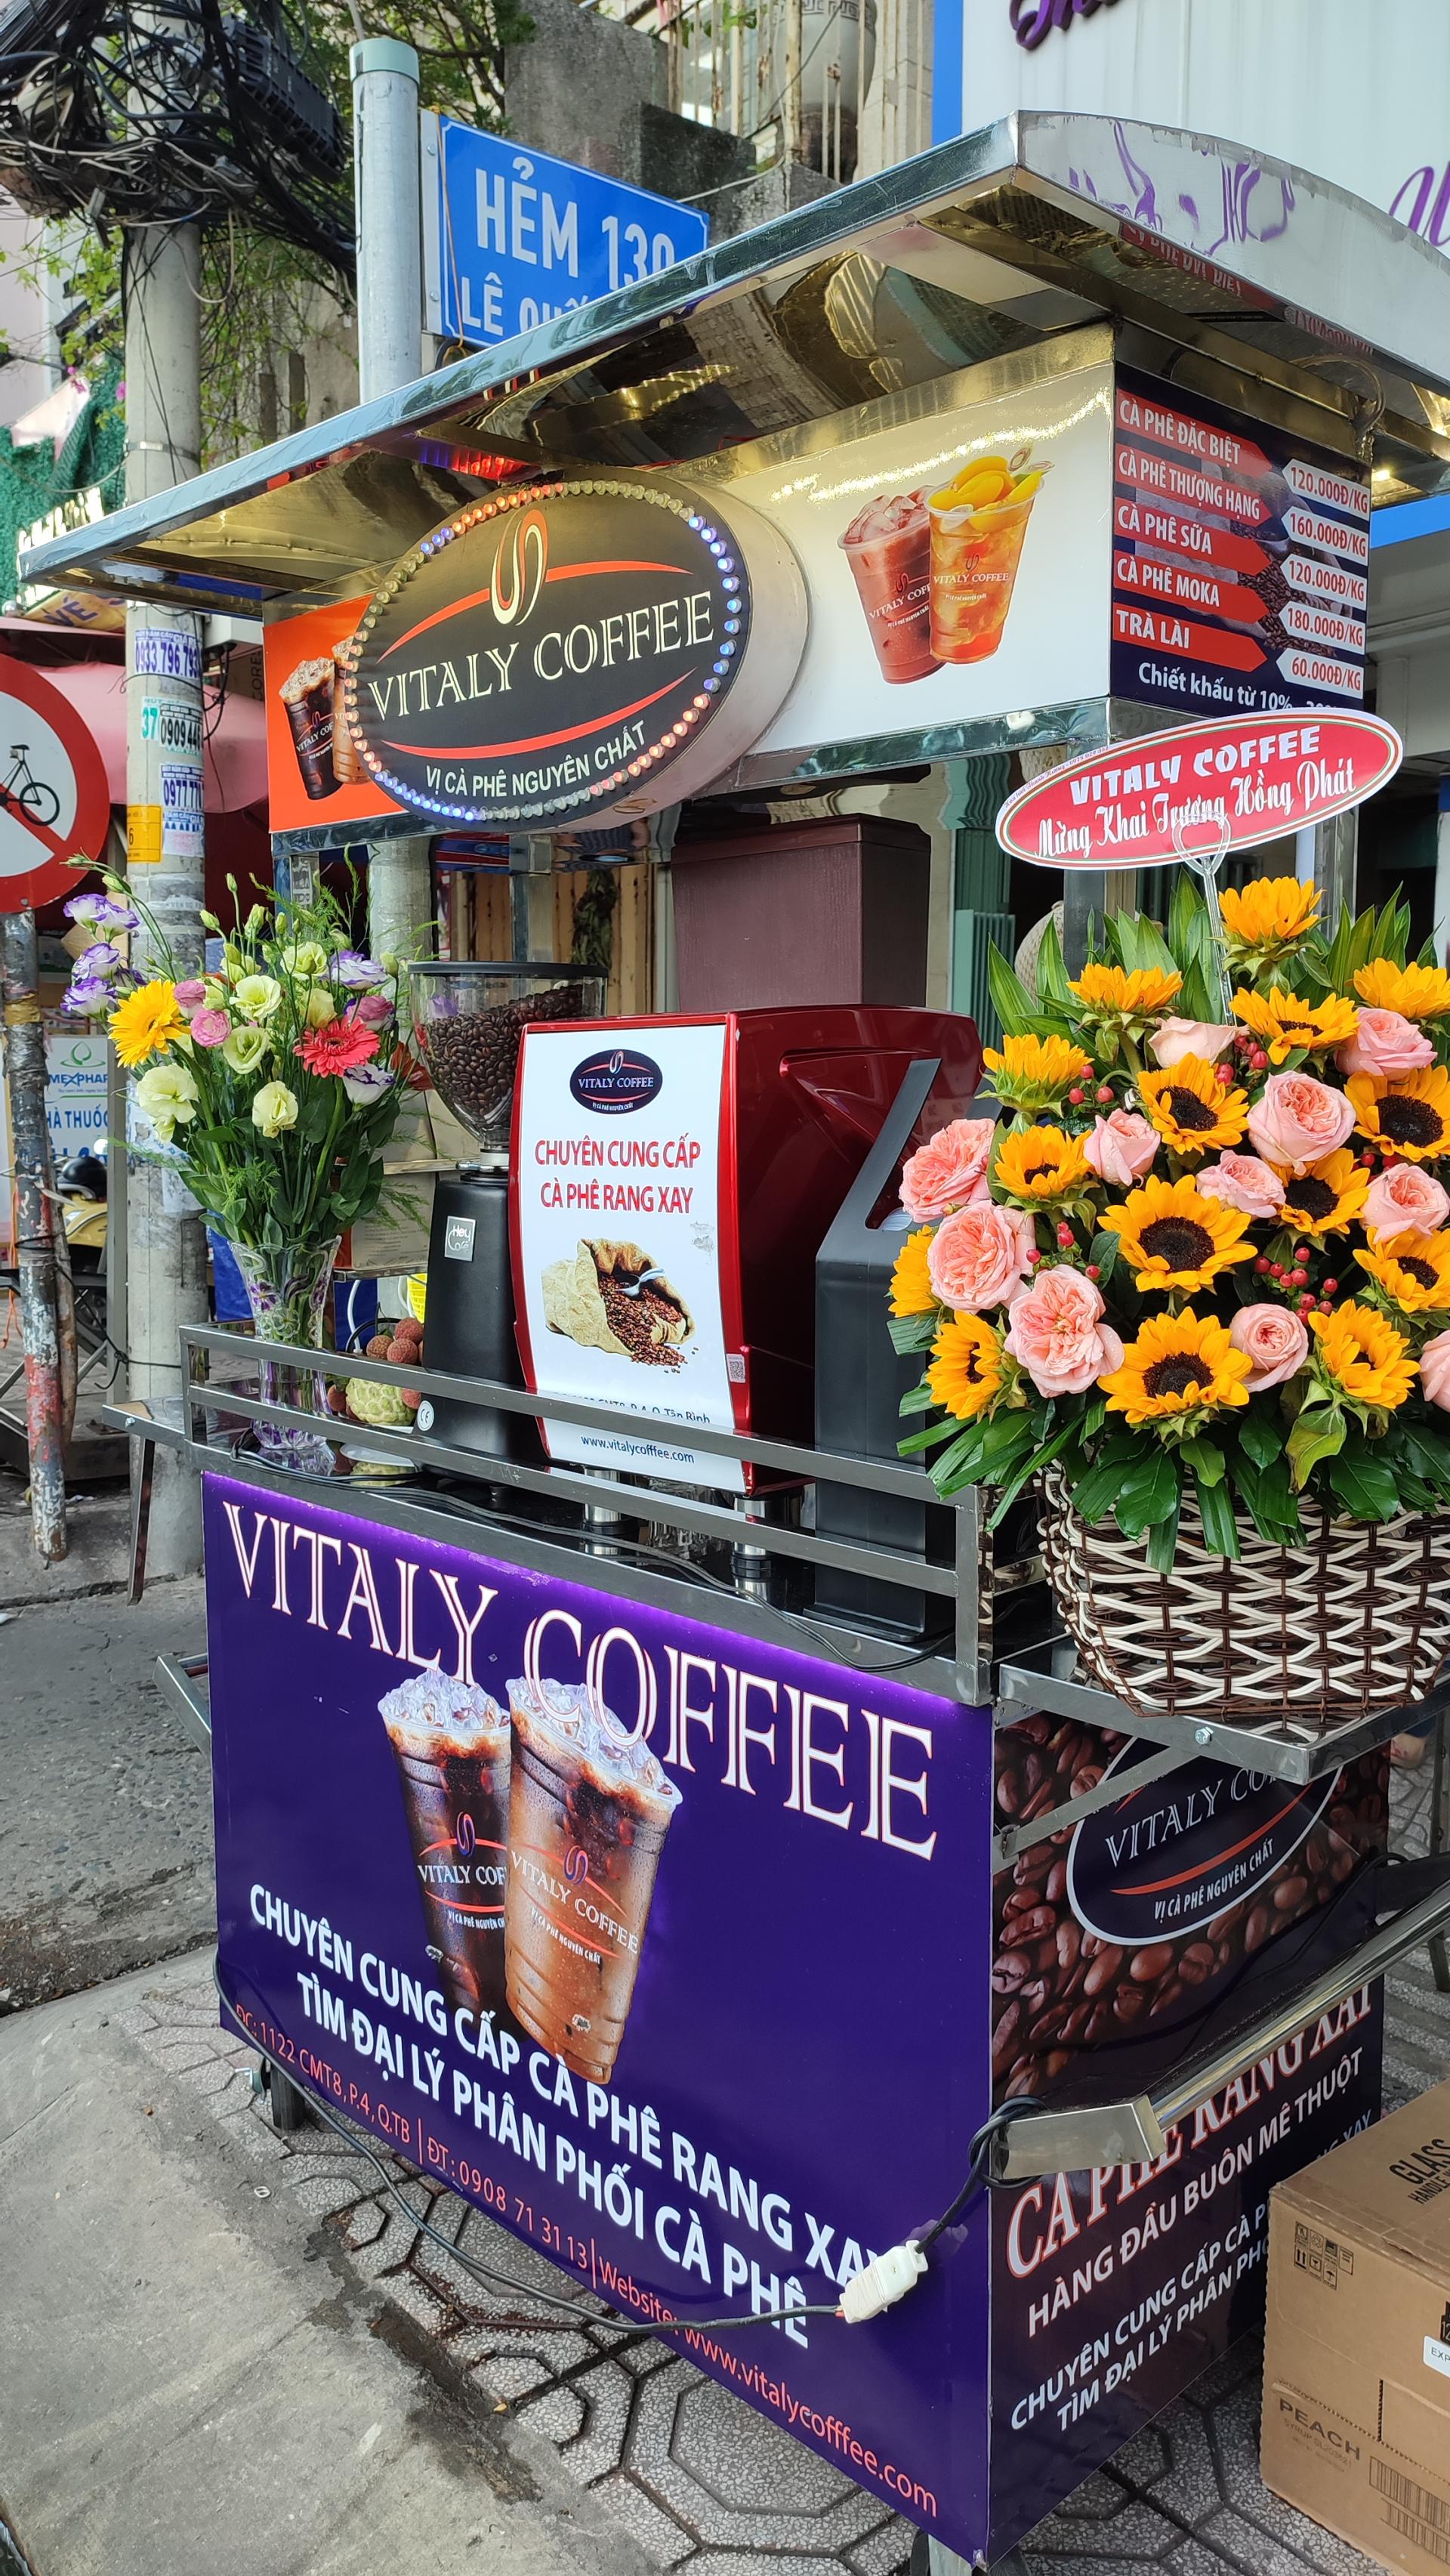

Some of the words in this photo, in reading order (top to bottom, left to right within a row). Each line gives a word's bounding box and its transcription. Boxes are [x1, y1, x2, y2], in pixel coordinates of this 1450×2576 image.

[476, 157, 578, 278] HẺM
[601, 216, 675, 290] 130
[461, 272, 503, 336] LÊ
[1119, 398, 1140, 428] CÀ
[1145, 413, 1174, 440] PHÊ
[1177, 424, 1206, 455] ĐẶC
[1210, 436, 1241, 468] BIỆT
[1118, 449, 1137, 482] CÀ
[1140, 461, 1167, 489] PHÊ
[1171, 469, 1223, 513] THƯỢNG
[1226, 494, 1260, 521] HẠNG
[1291, 466, 1368, 514] 120.000Đ/KG
[1118, 503, 1140, 532] CÀ
[1145, 516, 1176, 544] PHÊ
[1181, 524, 1212, 555] SỮA
[1290, 512, 1366, 558] 160.000Đ/KG
[868, 595, 905, 619] VITALY
[907, 583, 930, 601] COFF
[933, 574, 970, 584] VITALY
[972, 573, 1009, 582] COFFEE
[1117, 556, 1138, 585] CÀ
[1143, 566, 1172, 591] PHÊ
[1177, 574, 1220, 607] MOKA
[1289, 560, 1365, 605] 120.000Đ/KG
[368, 641, 520, 722] VITALY
[533, 590, 715, 681] COFFEE
[1116, 609, 1155, 641] TRÀ
[1161, 613, 1190, 649] LÀI
[1288, 607, 1363, 650] 180.000Đ/KG
[1138, 662, 1186, 693] Chiết
[1190, 672, 1233, 703] khấu
[1238, 684, 1257, 707] từ
[1260, 690, 1294, 710] 10%
[1292, 656, 1362, 690] 60.000Đ/KG
[296, 732, 319, 752] VITALY
[319, 722, 334, 737] COF
[426, 765, 442, 795] VỊ
[444, 769, 468, 795] CÀ
[473, 764, 508, 798] PHÊ
[511, 753, 591, 796] NGUYÊN
[594, 720, 648, 772] CHẤT
[1069, 754, 1182, 806] VITALY
[1192, 724, 1321, 778] COFFEE
[1035, 818, 1093, 860] Mừng
[1094, 803, 1150, 847] Khai
[1230, 772, 1294, 817] Hồng
[1296, 756, 1357, 811] Phát
[578, 1077, 614, 1089] VITALY
[616, 1076, 654, 1089] COFFEE
[47, 1106, 62, 1129] HÀ
[535, 1135, 604, 1166] CHUYÊN
[607, 1141, 659, 1168] CUNG
[662, 1132, 701, 1169] CẤP
[540, 1177, 563, 1209] CÀ
[566, 1178, 600, 1209] PHÊ
[603, 1185, 654, 1212] RANG
[658, 1186, 694, 1214] XAY
[221, 1500, 499, 1686] VITALY
[523, 1608, 939, 1861] COFFEE
[1104, 1779, 1225, 1870] VITALY
[417, 1864, 470, 1884] VITALY
[475, 1865, 507, 1886] COF
[511, 1849, 572, 1905] VITALY
[574, 1897, 639, 1955] COFFEE
[1154, 1900, 1166, 1924] VỊ
[1168, 1893, 1181, 1917] CÀ
[1183, 1886, 1205, 1913] PHÊ
[1206, 1861, 1248, 1903] NGUYÊN
[1249, 1838, 1275, 1873] CHẤT
[250, 1883, 354, 1982] CHUYÊN
[359, 1952, 448, 2037] CUNG
[454, 2009, 521, 2076] CẤP
[529, 2050, 579, 2118] CÀ
[586, 2080, 663, 2170] PHÊ
[671, 2130, 794, 2253] RANG
[297, 1971, 347, 2043] TÌM
[352, 2008, 405, 2082] ĐẠI
[411, 2043, 445, 2102] LÝ
[452, 2068, 546, 2173] PHÂN
[556, 2134, 644, 2241] PHỐI
[654, 2205, 712, 2285] CÀ
[723, 2241, 809, 2350] PHÊ
[458, 2160, 508, 2213] 0908
[514, 2196, 533, 2232] 71
[541, 2216, 560, 2251] 31
[1029, 2244, 1115, 2339] HÀNG
[1119, 2194, 1177, 2266] ĐẦU
[1183, 2135, 1254, 2216] BUÔN
[1258, 2101, 1291, 2155] MÊ
[1294, 2046, 1363, 2124] THUỘT
[1010, 2331, 1109, 2431] CHUYÊN
[1114, 2277, 1177, 2346] CUNG
[1180, 2241, 1221, 2290] CẤP
[1224, 2213, 1251, 2253] CÀ
[1057, 2377, 1100, 2432] TÌM
[1104, 2340, 1143, 2394] ĐẠI
[1149, 2313, 1173, 2357] LÝ
[1176, 2264, 1232, 2333] PHÂN
[1279, 2398, 1360, 2461] PEACH
